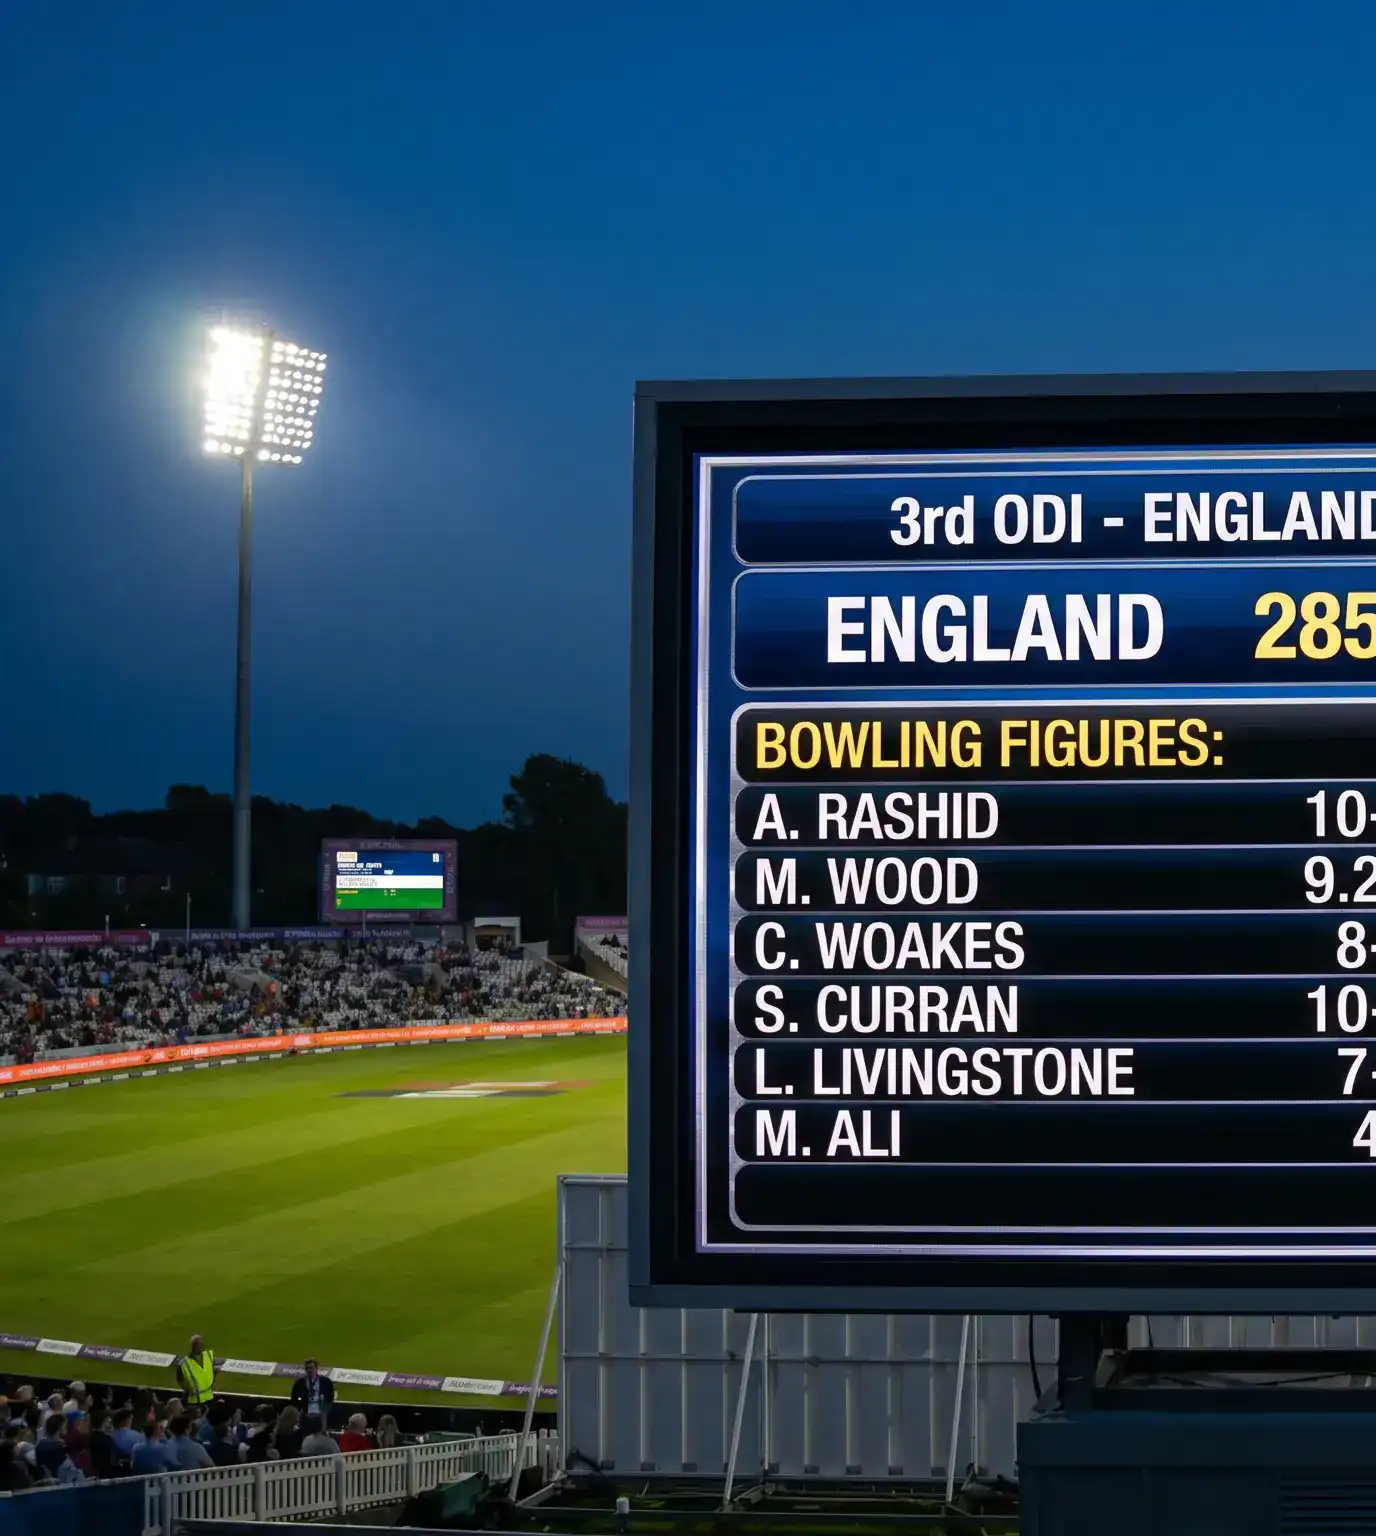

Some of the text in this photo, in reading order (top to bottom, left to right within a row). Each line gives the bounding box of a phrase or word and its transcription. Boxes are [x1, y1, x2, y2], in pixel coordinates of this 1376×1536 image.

[890, 494, 975, 546] 3rd
[993, 493, 1082, 545] ODI
[1103, 517, 1124, 527] -
[827, 593, 1164, 663] ENGLAND
[756, 718, 1223, 769] BOWLING FIGURES:
[752, 793, 799, 840] A.
[818, 791, 999, 840] RASHID
[756, 858, 811, 905] M.
[826, 856, 979, 906] WOOD
[755, 921, 799, 970] C.
[815, 920, 1025, 970] WOAKES
[754, 984, 799, 1034] S.
[816, 984, 1018, 1034] CURRAN
[755, 1048, 794, 1095] L.
[813, 1046, 1135, 1096] LIVINGSTONE
[756, 1109, 811, 1157] M.
[826, 1109, 901, 1157] ALI
